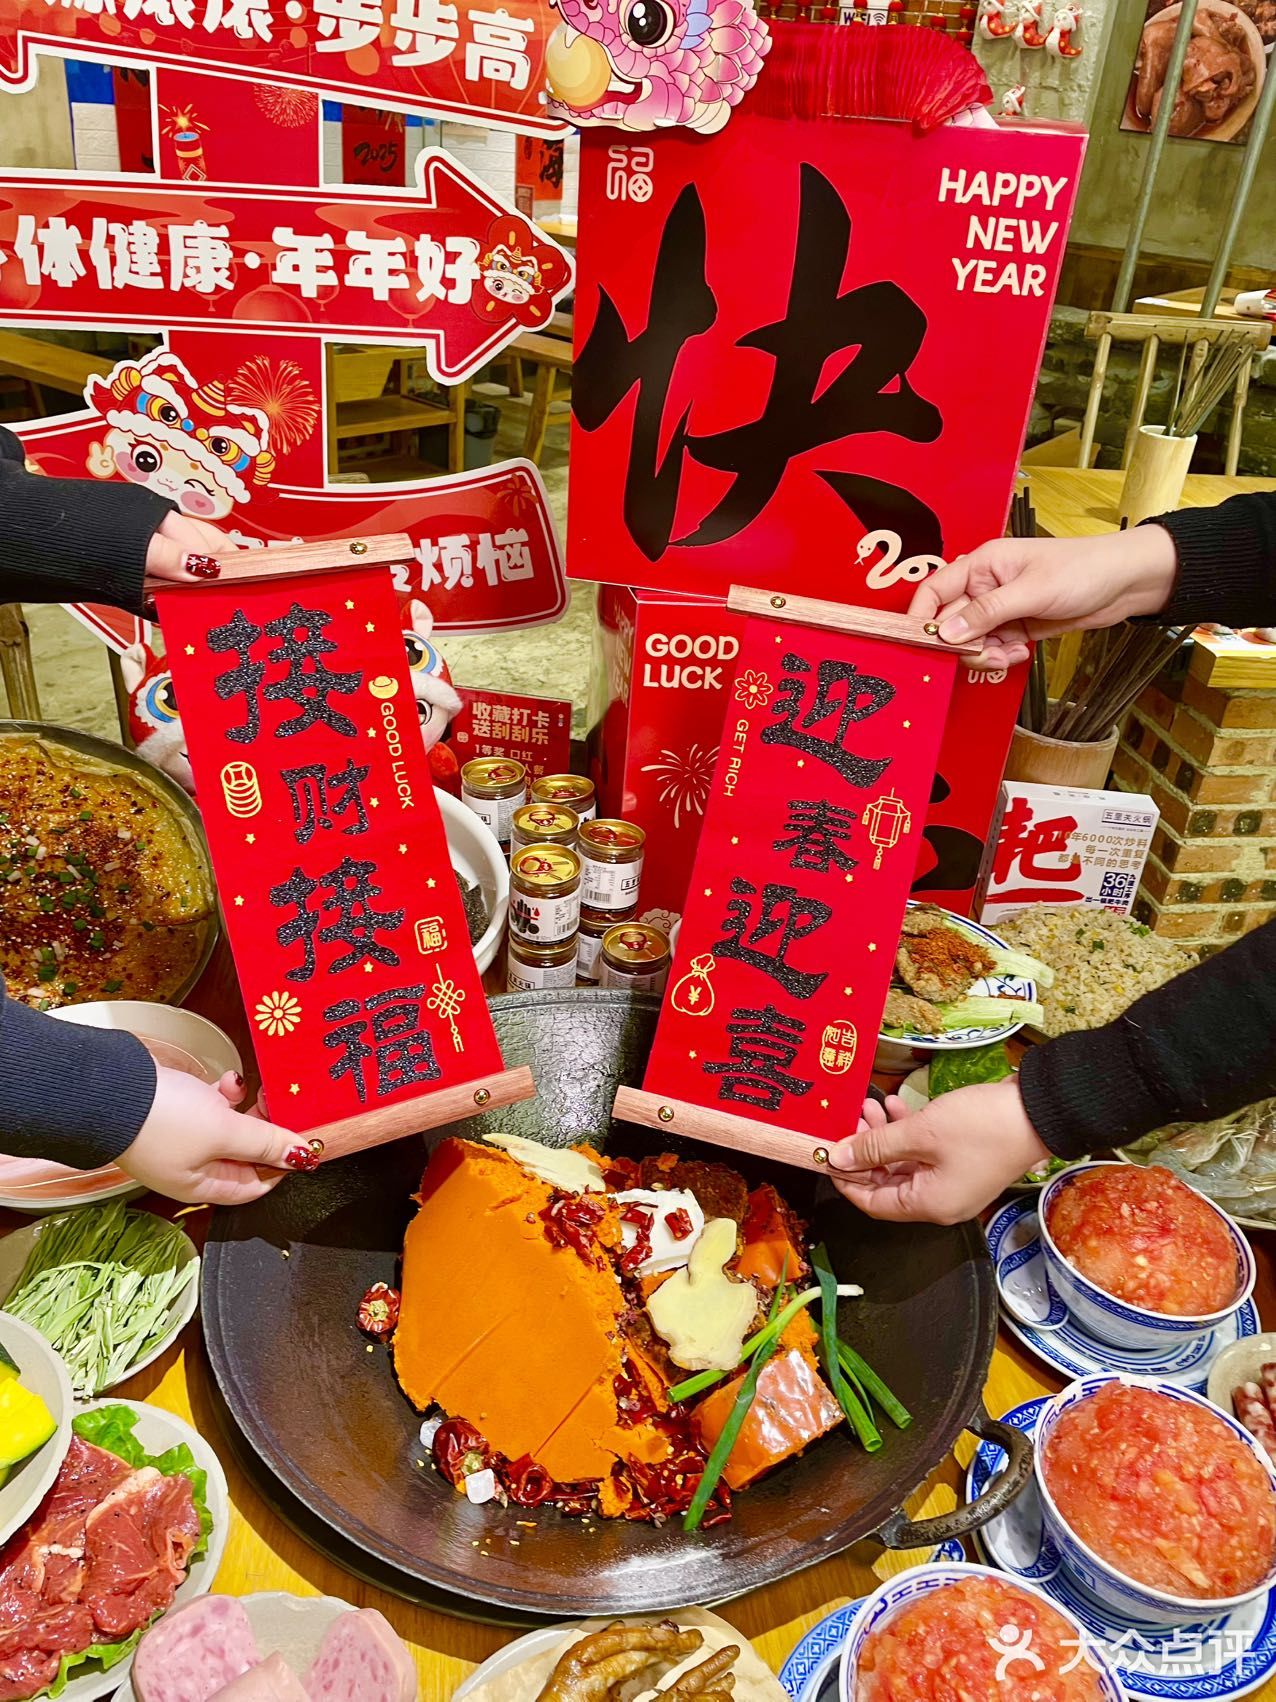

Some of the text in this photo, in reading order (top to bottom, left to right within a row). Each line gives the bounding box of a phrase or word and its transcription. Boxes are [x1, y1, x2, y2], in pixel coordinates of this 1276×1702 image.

[938, 167, 1068, 211] HAPPY
[966, 215, 1059, 254] NEW
[0, 215, 481, 305] 体健康·年年好
[951, 257, 1046, 297] YEAR
[571, 161, 944, 563] 快
[645, 633, 740, 660] GOOD
[643, 663, 723, 690] LUCK
[472, 702, 550, 728] 收藏打卡
[472, 719, 549, 745] 送刮刮乐
[381, 702, 415, 809] GOOD LUCK
[475, 744, 533, 761] 1等奖 口红
[723, 719, 749, 797] GET RICH
[206, 602, 442, 1104] 接财接福
[1085, 844, 1145, 859] 每一次重复
[702, 652, 897, 1111] 迎春迎喜
[1101, 887, 1124, 897] 小时
[1103, 873, 1127, 888] 36
[420, 921, 442, 949] 福
